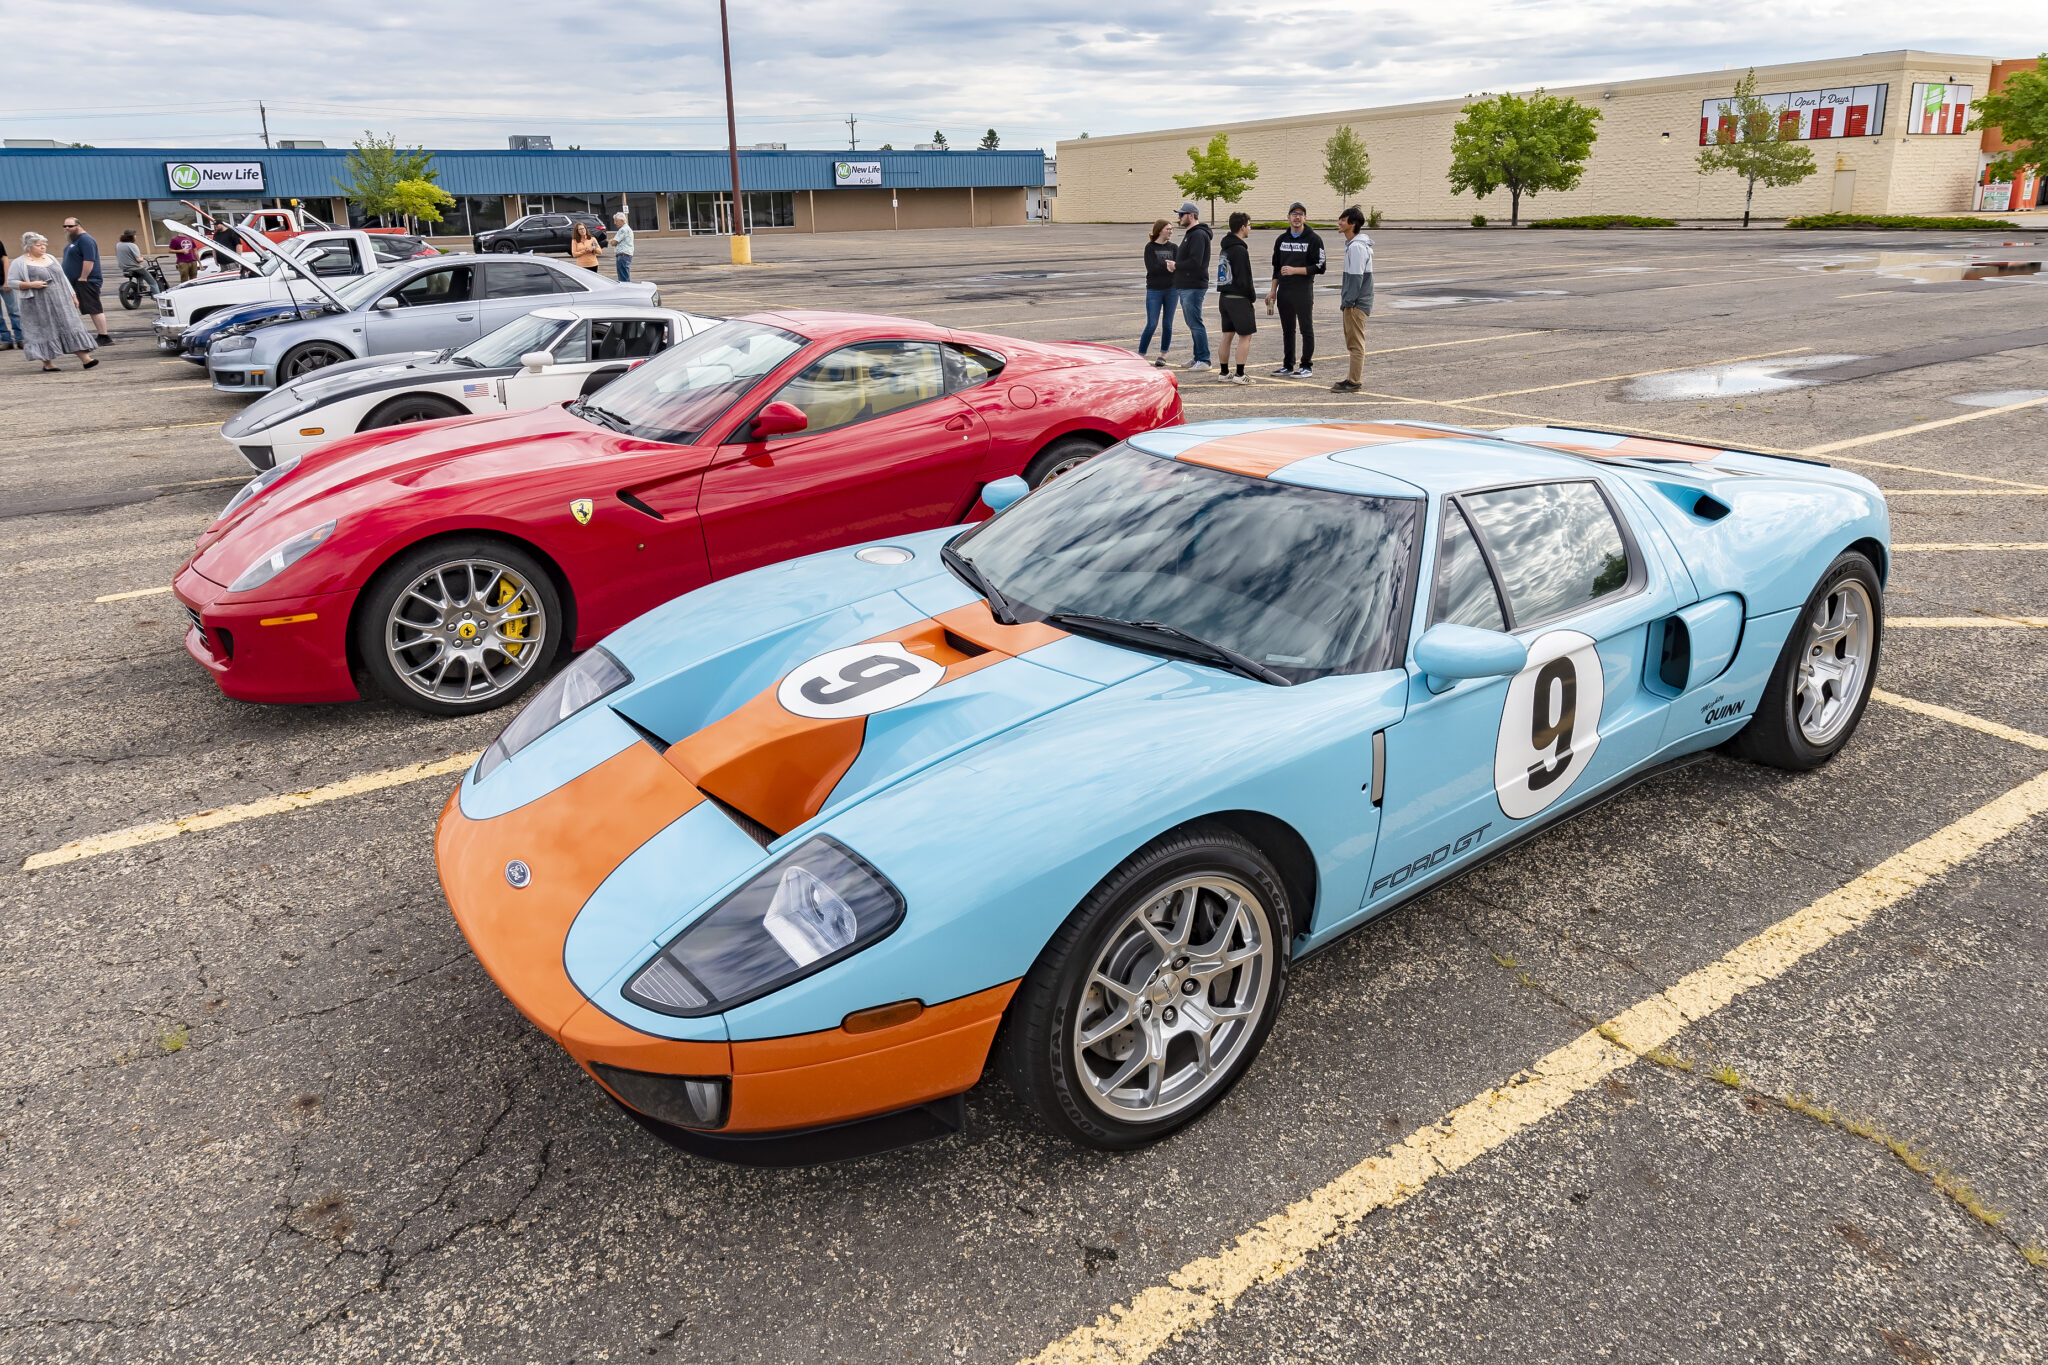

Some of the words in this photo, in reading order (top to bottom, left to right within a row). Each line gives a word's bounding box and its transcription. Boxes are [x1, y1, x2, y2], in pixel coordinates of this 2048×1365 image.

[1795, 97, 1816, 108] Open
[1828, 94, 1850, 105] Days
[203, 169, 233, 180] New
[235, 168, 259, 180] Life
[868, 165, 880, 173] Life
[800, 654, 921, 705] 9
[1527, 656, 1577, 791] 9
[1705, 699, 1746, 725] QUINN
[1369, 844, 1451, 899] FORD
[1452, 821, 1493, 855] GT
[1051, 1006, 1107, 1141] GOODYEAR
